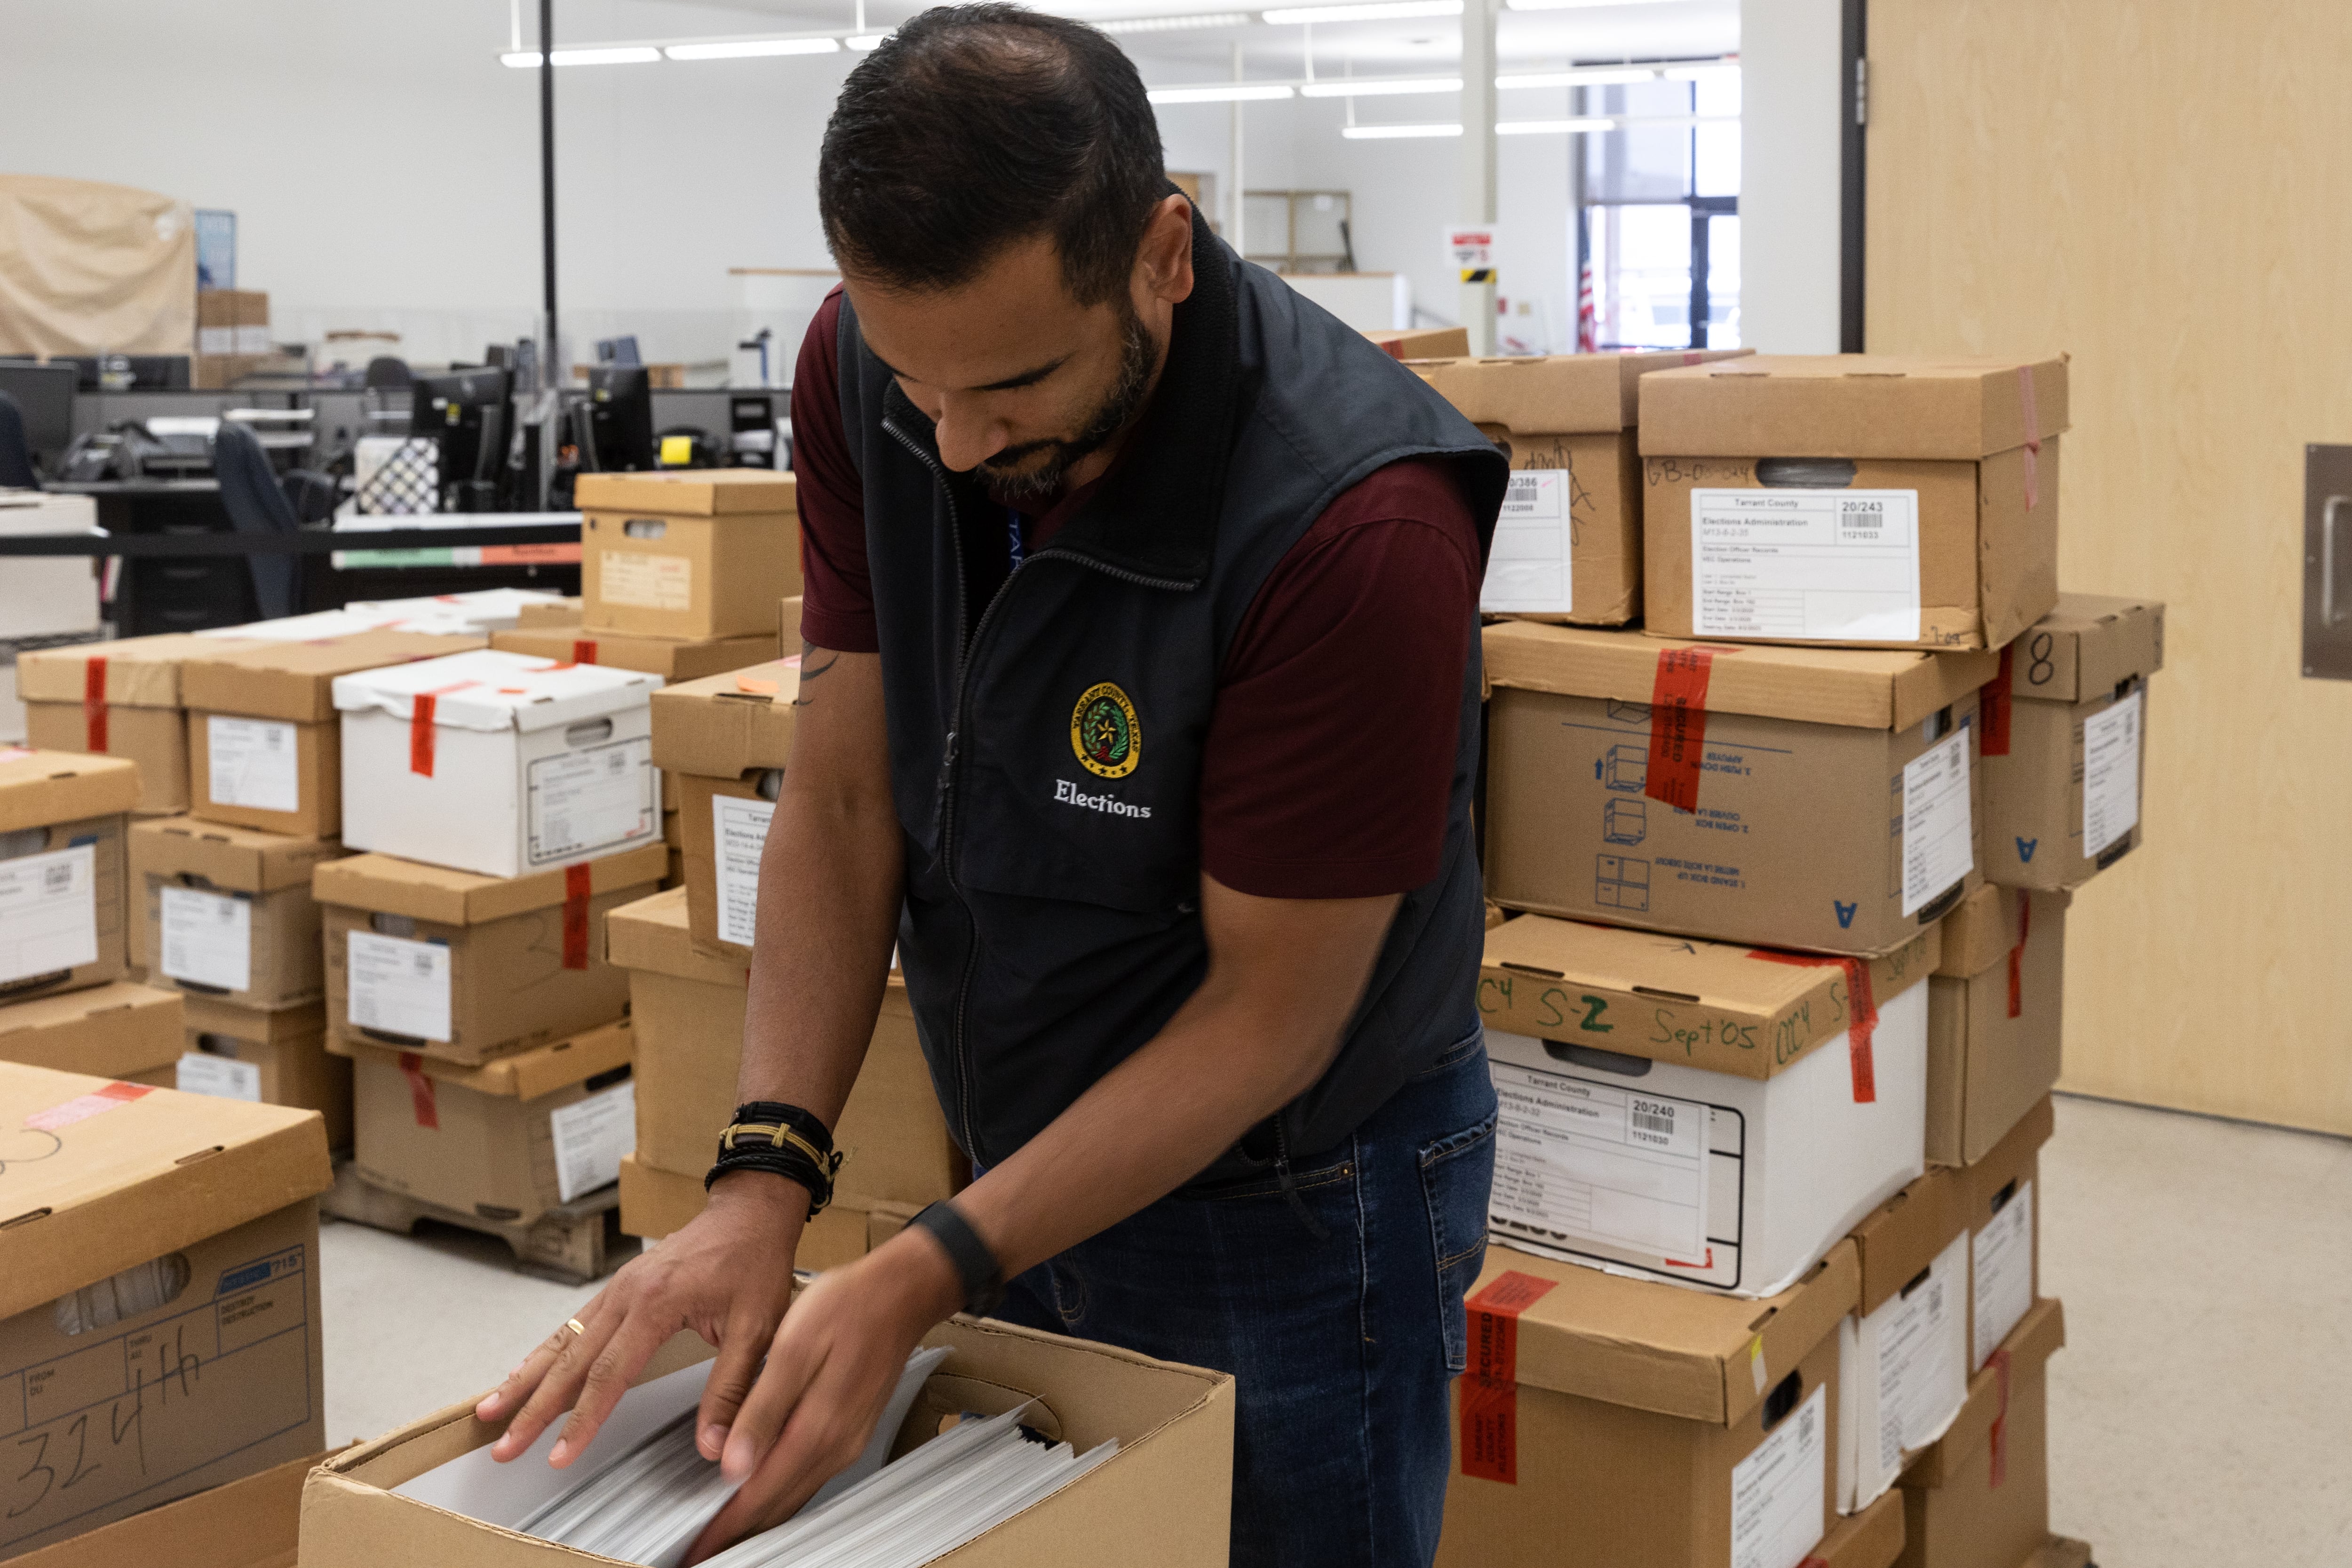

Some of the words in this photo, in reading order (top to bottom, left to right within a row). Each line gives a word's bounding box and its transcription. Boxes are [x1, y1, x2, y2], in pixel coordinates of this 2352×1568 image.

[1509, 477, 1538, 487] 0/386
[1735, 498, 1765, 507] Tarrant
[1767, 499, 1800, 508] County
[1843, 501, 1883, 512] 20/243
[1702, 517, 1741, 526] Elections
[1744, 518, 1809, 526] Administration
[2028, 632, 2054, 685] 8
[1053, 779, 1152, 819] Elections
[2015, 836, 2038, 863] A
[1834, 899, 1858, 929] A
[1478, 978, 1513, 1012] C4
[1650, 1007, 1712, 1057] Sept
[1527, 1075, 1558, 1089] Tarrant
[1559, 1082, 1591, 1098] County
[1496, 1087, 1534, 1104] Elections
[1536, 1097, 1599, 1118] Administration
[1633, 1099, 1675, 1118] 20/240
[1479, 1312, 1494, 1389] SECURED
